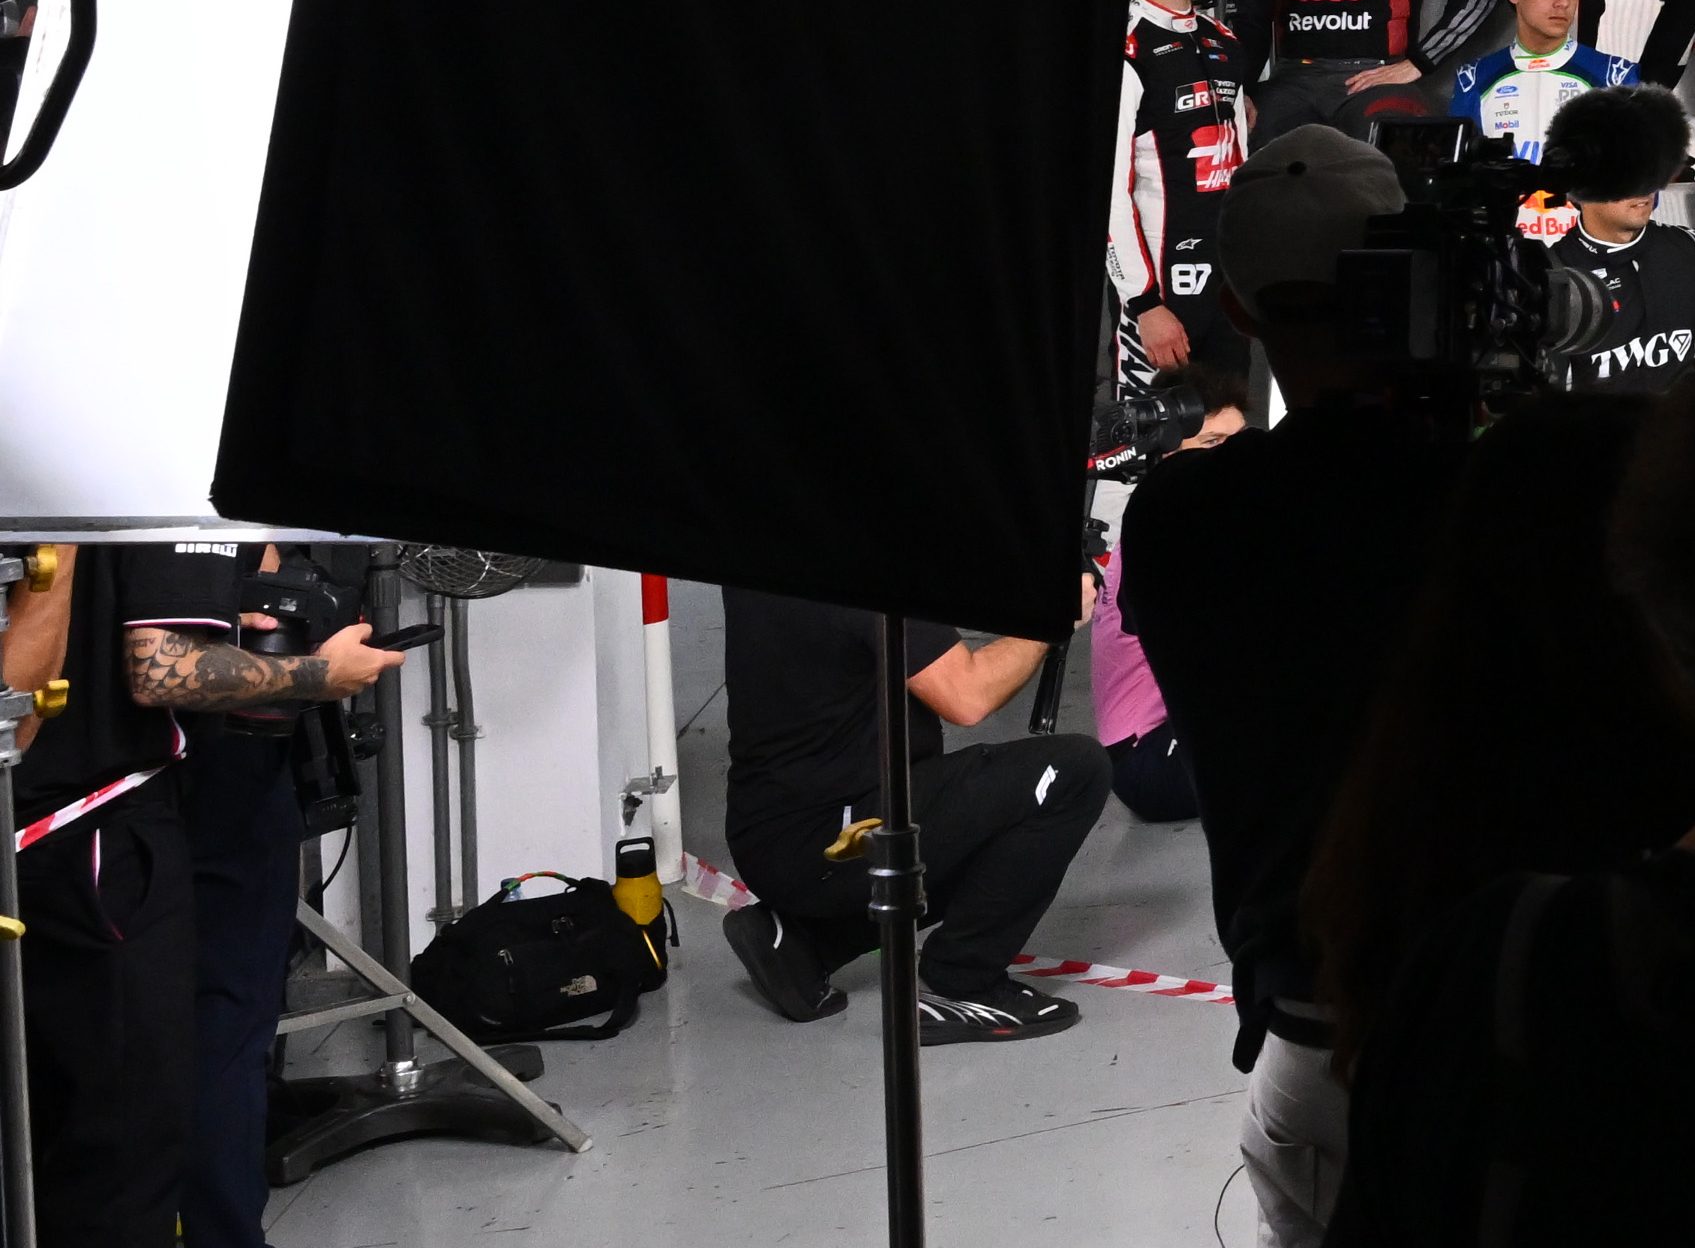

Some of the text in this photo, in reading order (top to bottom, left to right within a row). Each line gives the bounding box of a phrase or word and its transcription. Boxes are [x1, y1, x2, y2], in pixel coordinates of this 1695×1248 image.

[1289, 11, 1372, 31] Revolut
[1178, 91, 1211, 110] GR
[1495, 109, 1519, 117] TUDOR
[1494, 120, 1519, 130] Mobil
[1513, 141, 1541, 165] VI
[1517, 217, 1541, 235] ed
[1171, 263, 1212, 295] 87
[1592, 333, 1669, 378] TWG
[1095, 446, 1137, 472] RONIN
